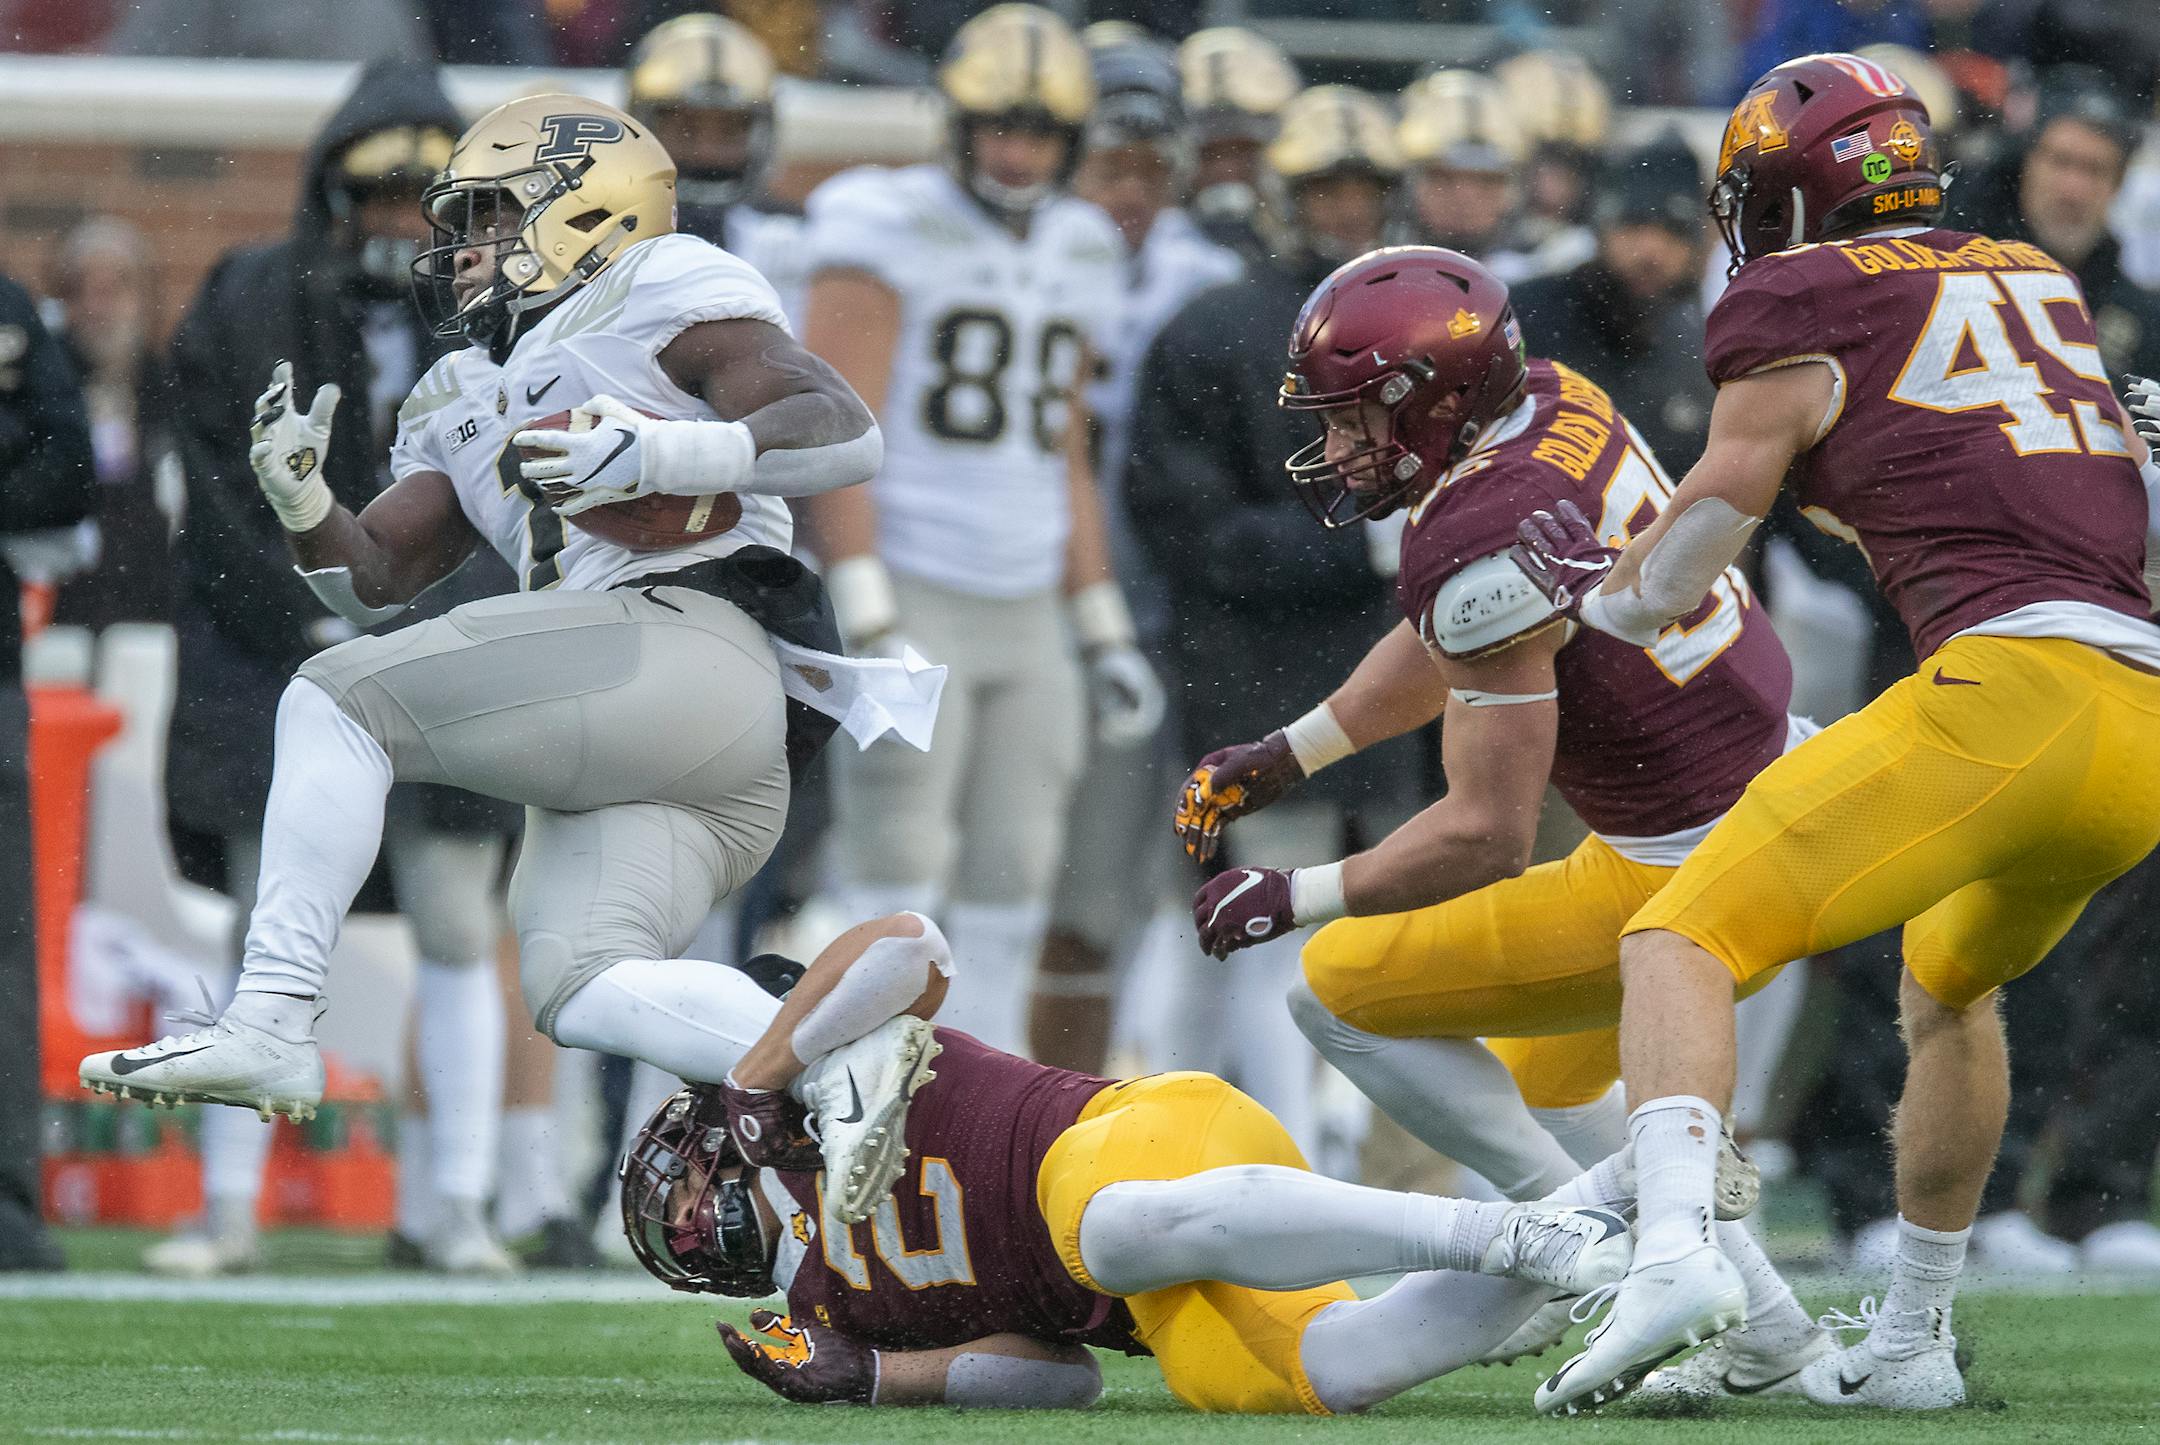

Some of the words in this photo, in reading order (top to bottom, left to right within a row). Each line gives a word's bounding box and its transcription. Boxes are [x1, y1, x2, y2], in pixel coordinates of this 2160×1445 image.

[534, 113, 625, 164] P
[1717, 89, 1788, 177] M
[1887, 271, 2133, 457] 45
[1531, 410, 1611, 481] GOLDEN
